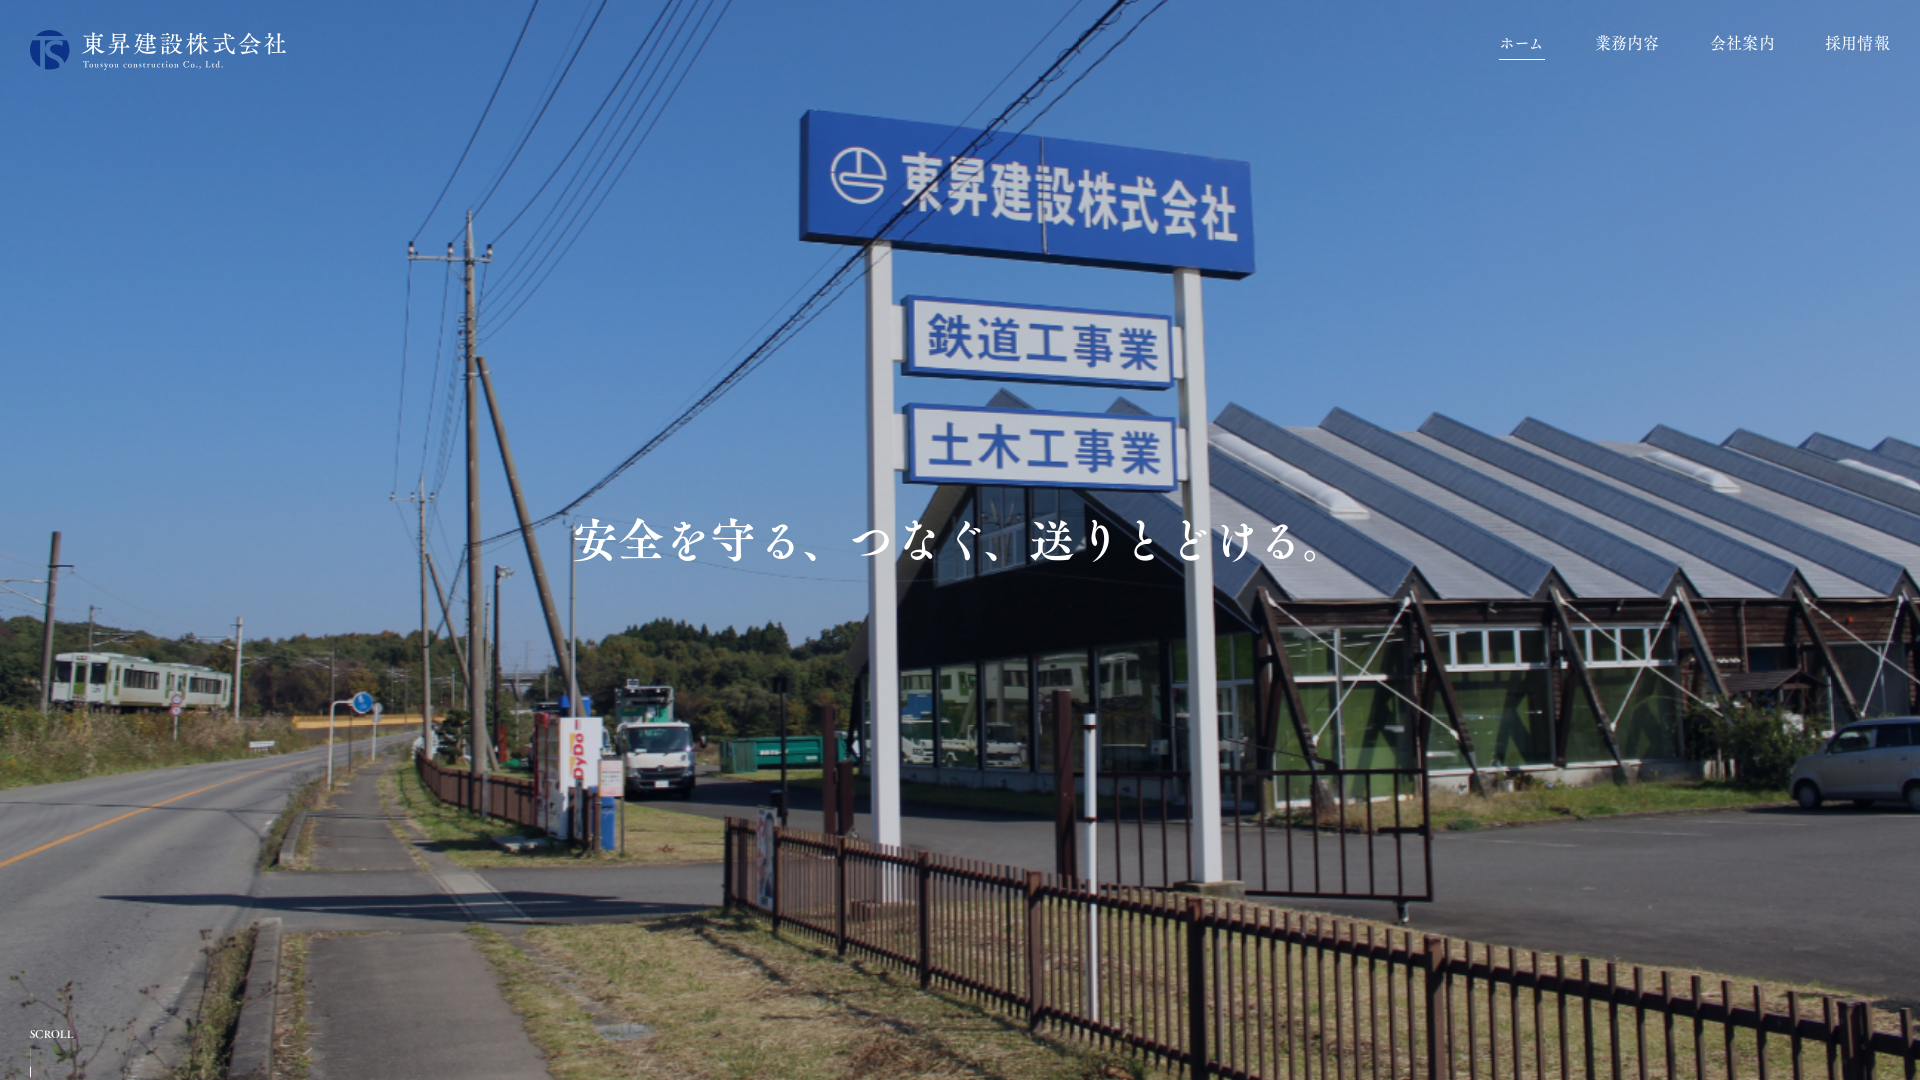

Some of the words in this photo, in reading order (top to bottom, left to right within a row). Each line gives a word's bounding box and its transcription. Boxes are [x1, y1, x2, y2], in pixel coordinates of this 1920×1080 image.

[901, 151, 1238, 242] 東昇建設株式会社
[927, 312, 1158, 372] 鉄道工事業
[928, 421, 1161, 475] 土木工事業
[573, 733, 587, 779] DyDo
